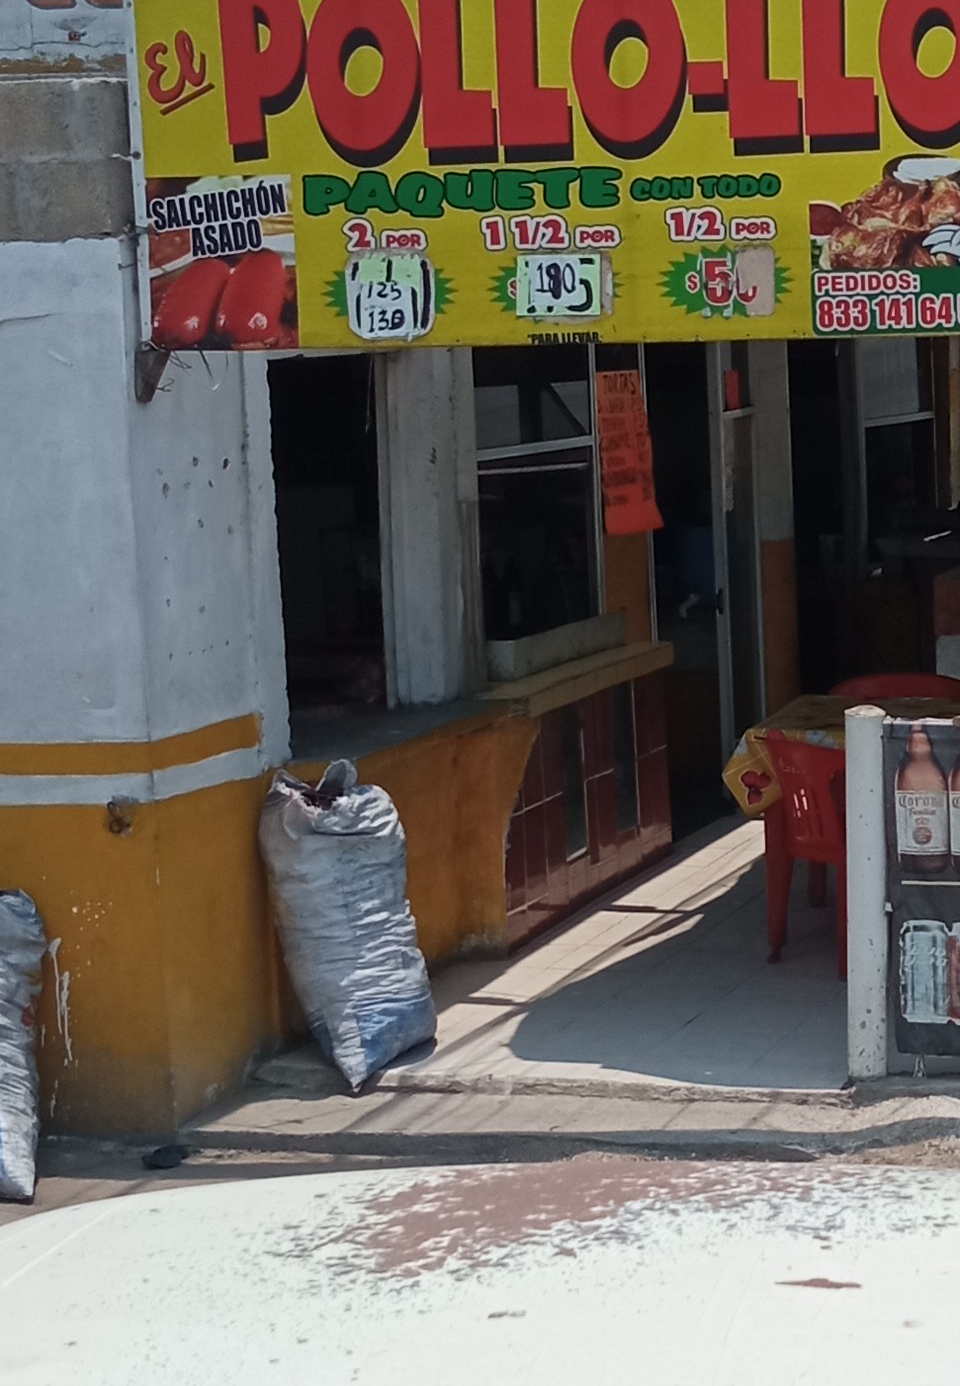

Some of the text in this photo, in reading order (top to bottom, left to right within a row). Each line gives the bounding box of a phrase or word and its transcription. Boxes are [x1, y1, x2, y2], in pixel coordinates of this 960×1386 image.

[144, 30, 211, 108] El
[151, 180, 287, 231] SALCHICHÓN
[302, 167, 780, 217] PAQUETE CON TODO
[191, 218, 263, 257] ASADO
[347, 220, 423, 249] 2 POR
[577, 227, 618, 245] POR
[669, 210, 772, 237] 1/2 POR
[816, 273, 918, 293] PEDIDOS:
[817, 298, 869, 329] 833
[874, 296, 914, 327] 141
[920, 295, 953, 326] 64
[602, 372, 636, 396] TORTAS
